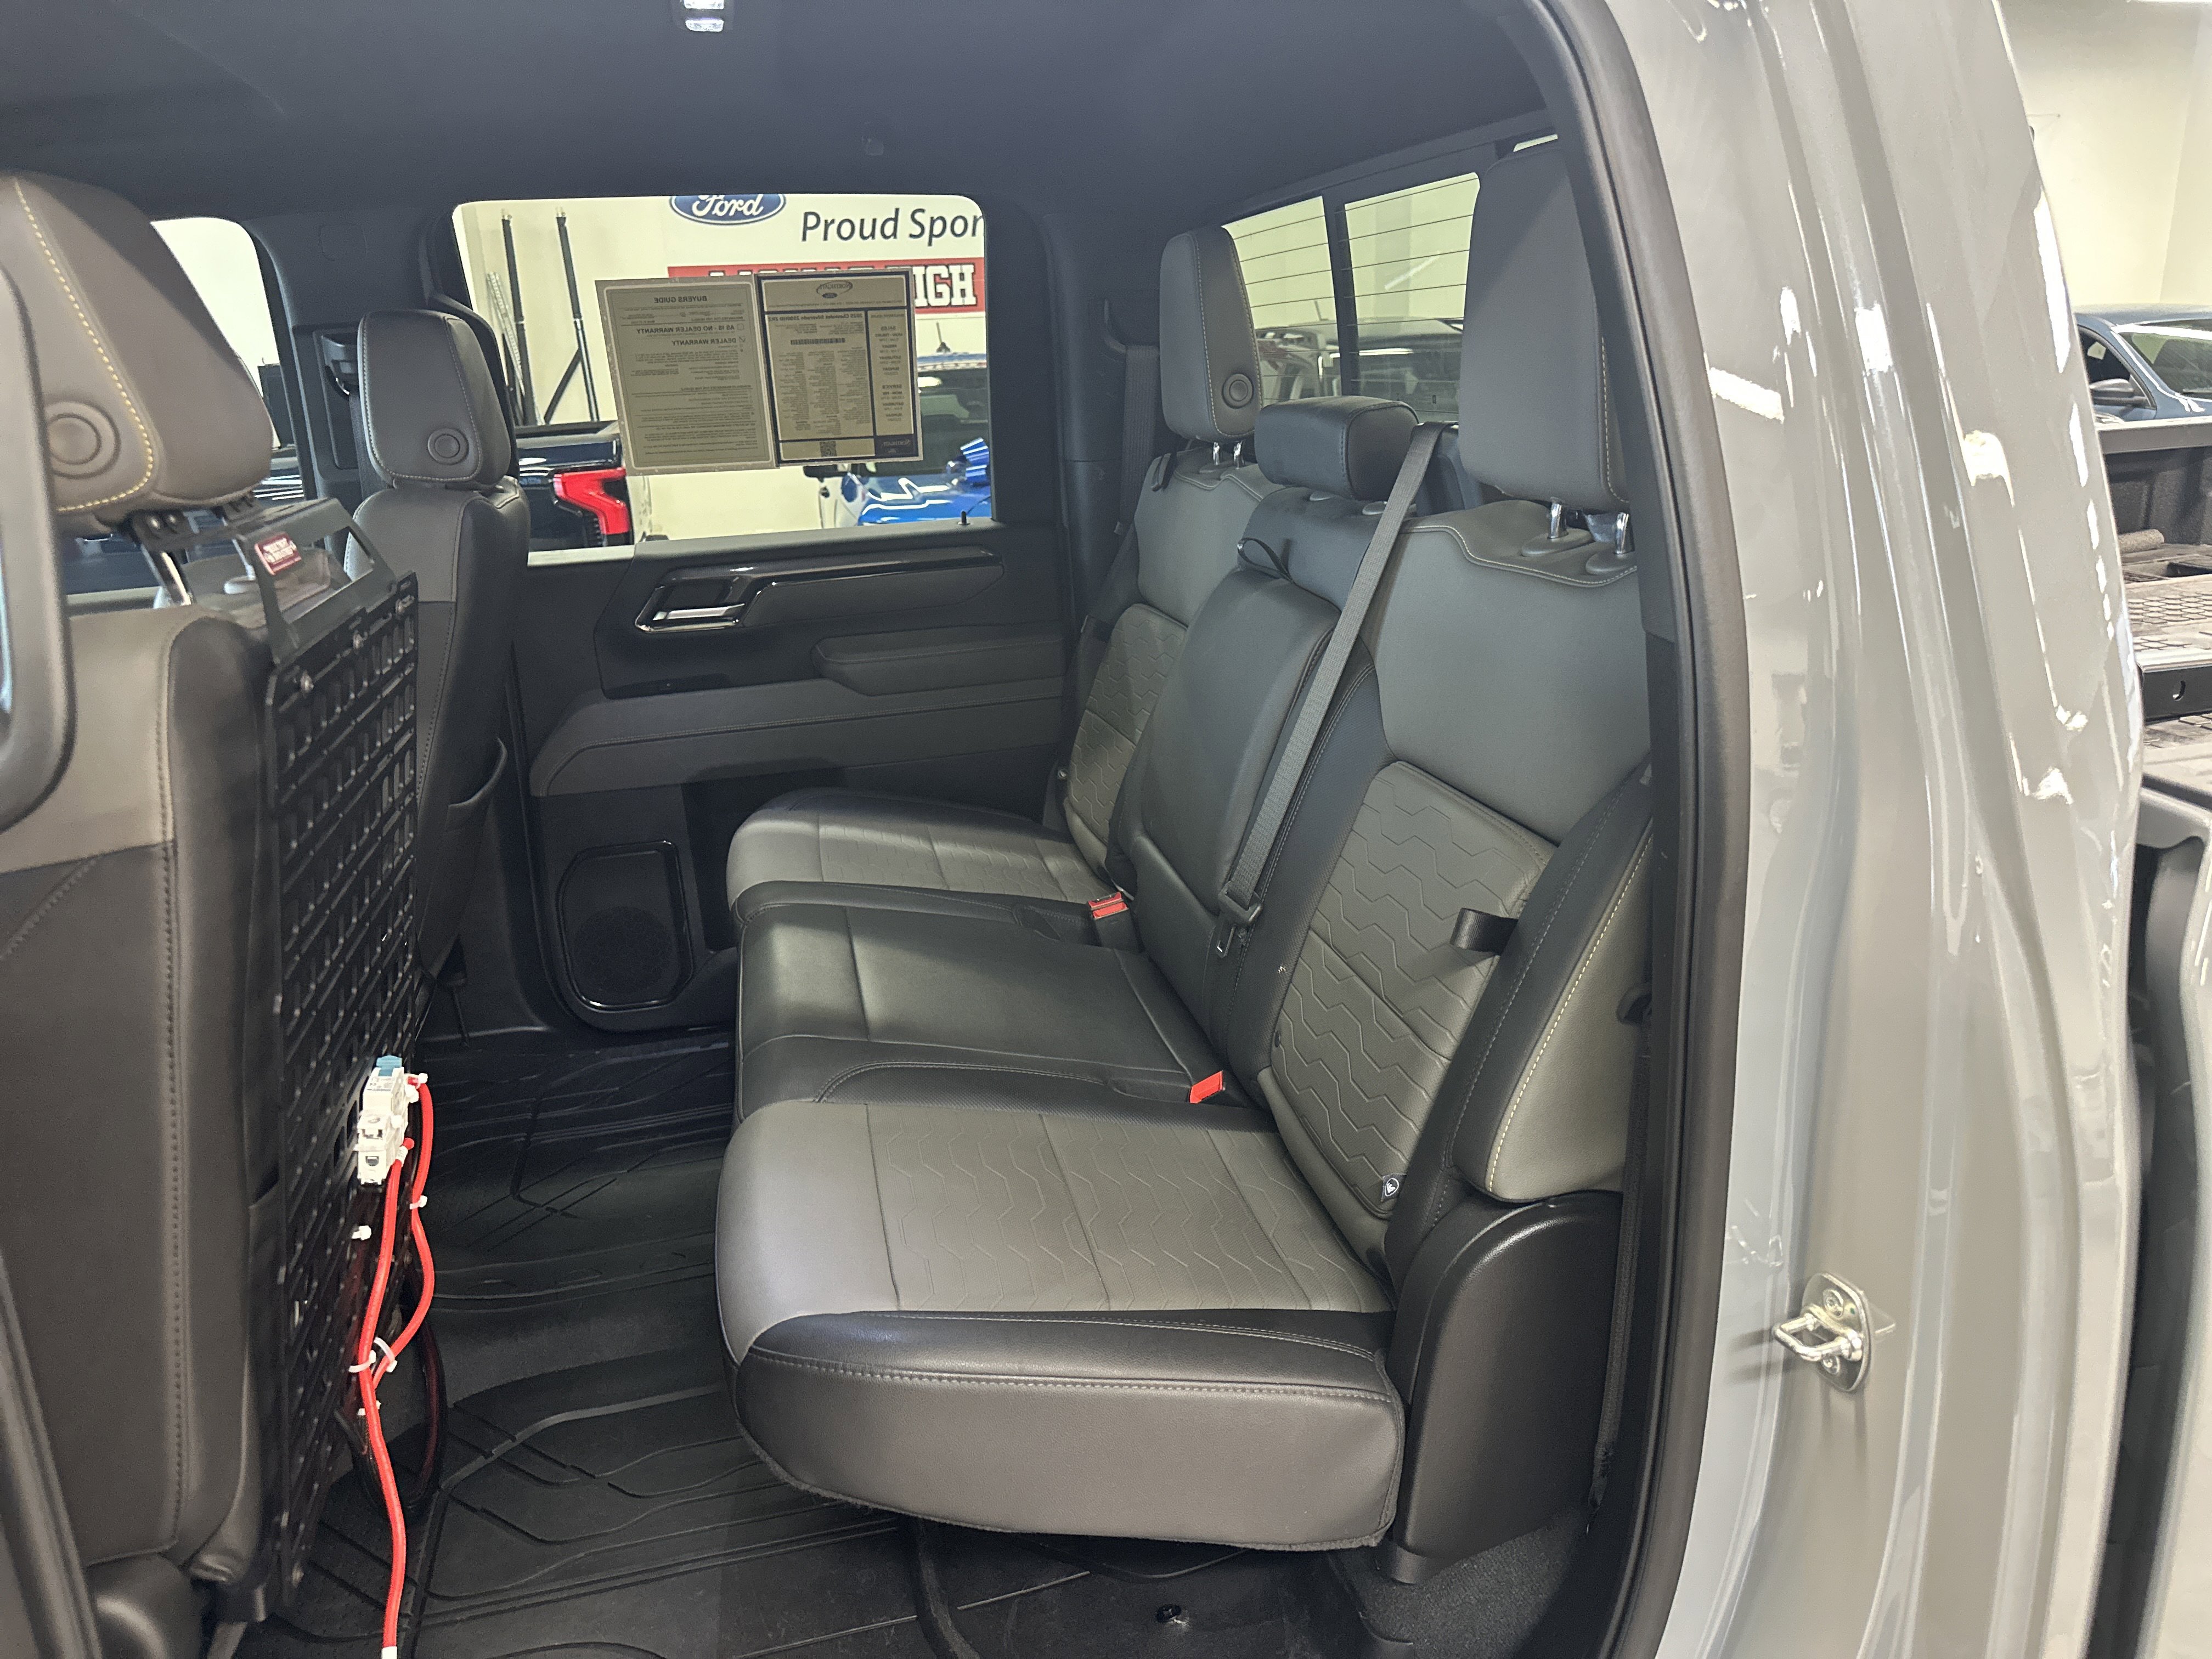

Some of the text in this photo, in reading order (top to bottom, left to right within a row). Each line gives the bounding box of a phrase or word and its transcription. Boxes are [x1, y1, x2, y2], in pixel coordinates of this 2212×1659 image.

[692, 194, 764, 217] Ford
[801, 207, 900, 242] Proud
[900, 263, 978, 308] IGH
